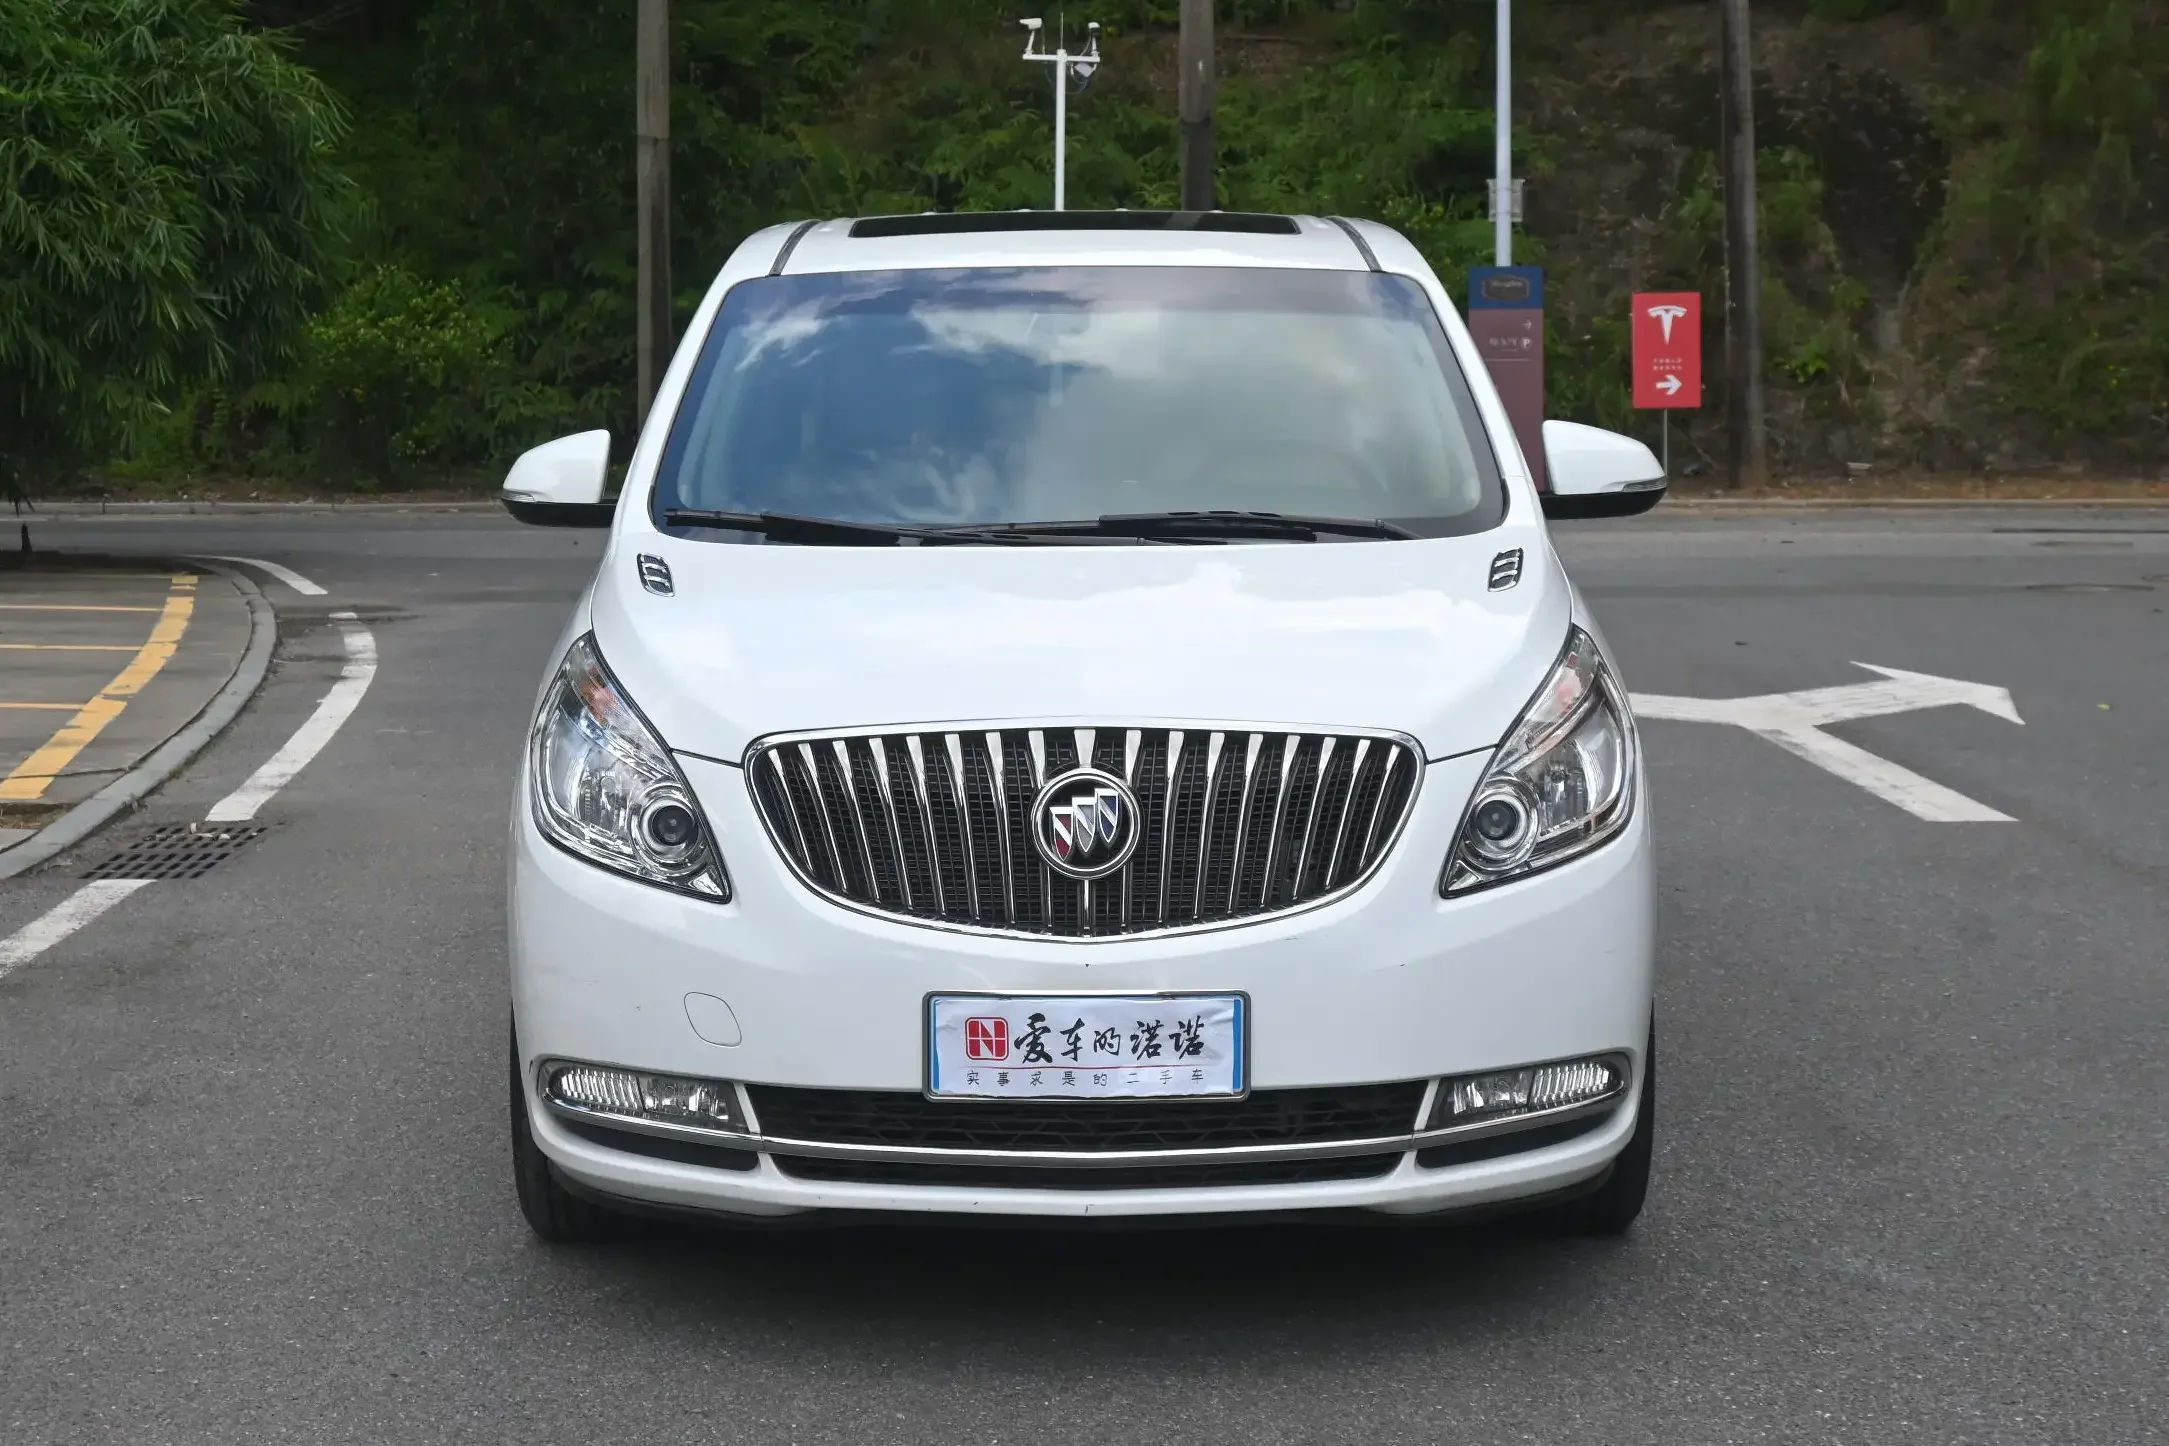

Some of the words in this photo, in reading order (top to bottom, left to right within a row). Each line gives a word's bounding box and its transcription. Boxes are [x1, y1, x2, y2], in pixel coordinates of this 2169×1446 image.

[1014, 1013, 1205, 1063] 爱车的诺诺
[966, 1068, 1204, 1087] 实事求是的二手车
